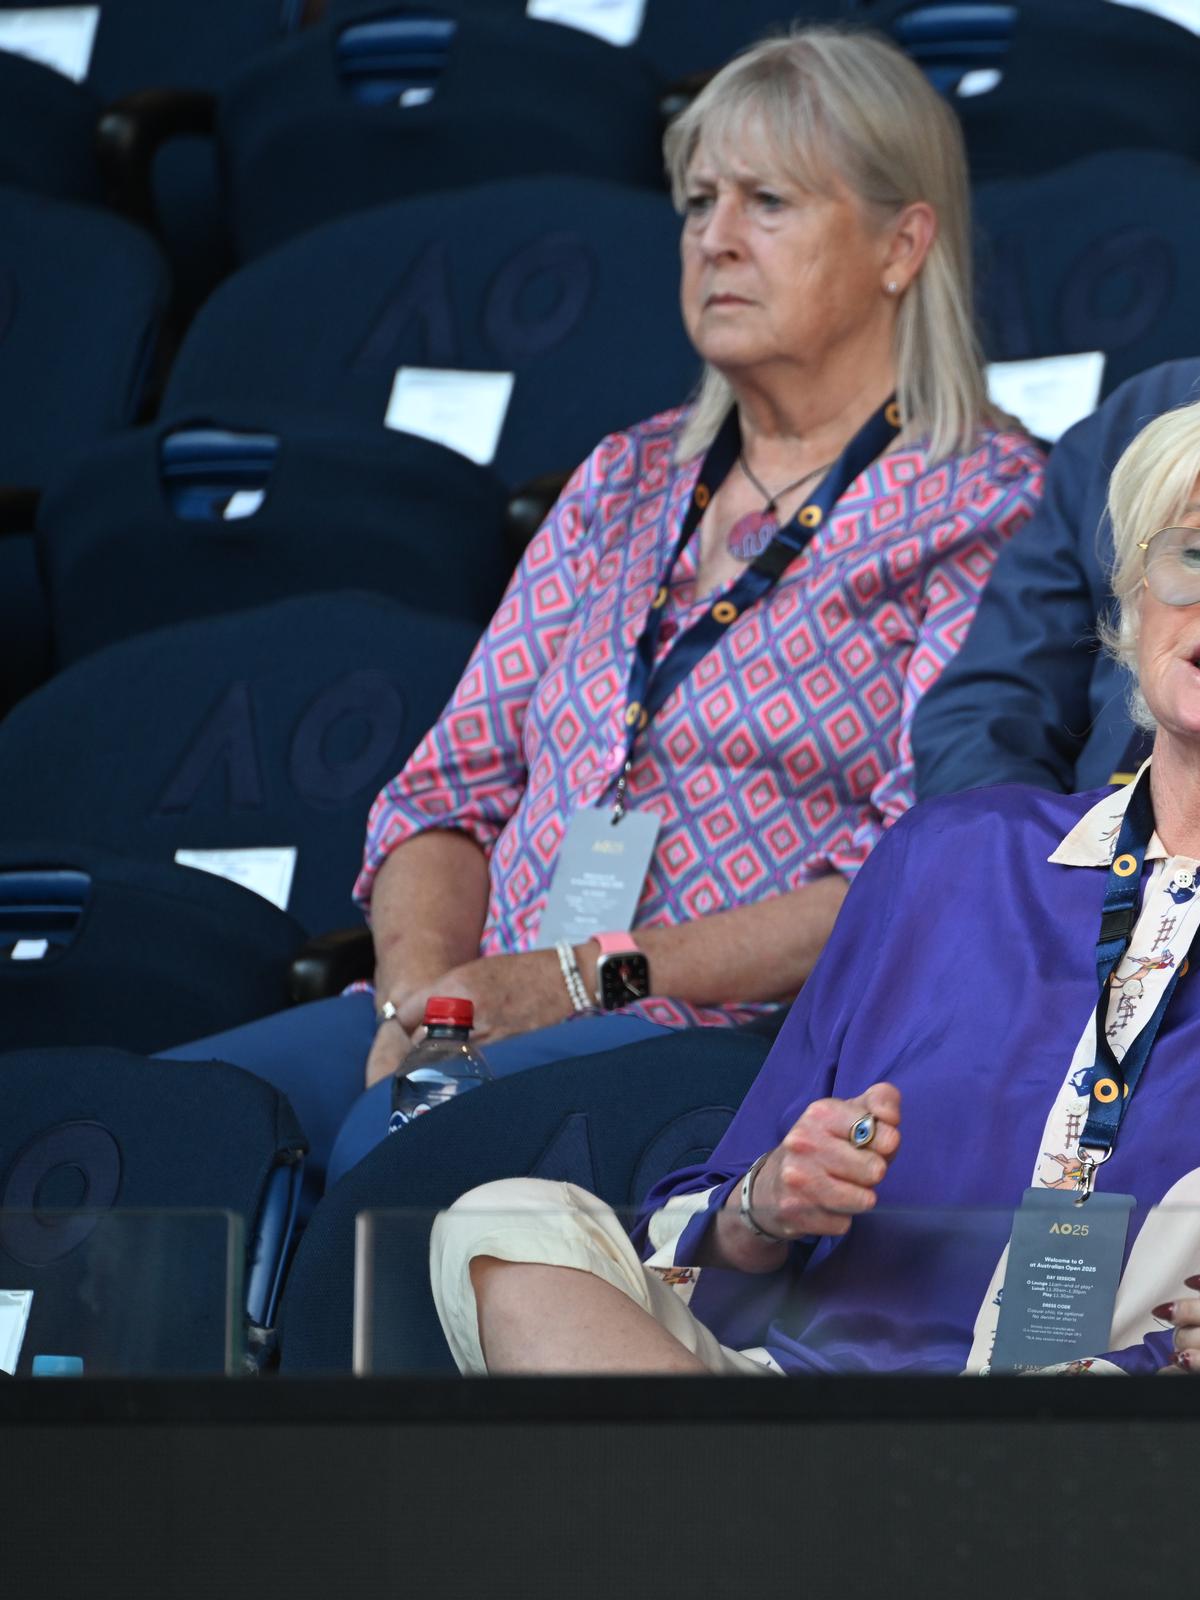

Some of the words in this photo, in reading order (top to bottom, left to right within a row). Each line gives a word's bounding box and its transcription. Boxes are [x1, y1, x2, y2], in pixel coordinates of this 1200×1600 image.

[353, 229, 598, 370] AO
[153, 667, 407, 817] AO
[1049, 1222, 1089, 1236] AO25
[1044, 1256, 1070, 1264] Welcome
[1037, 1262, 1065, 1270] Australian
[1081, 1265, 1096, 1273] 2025
